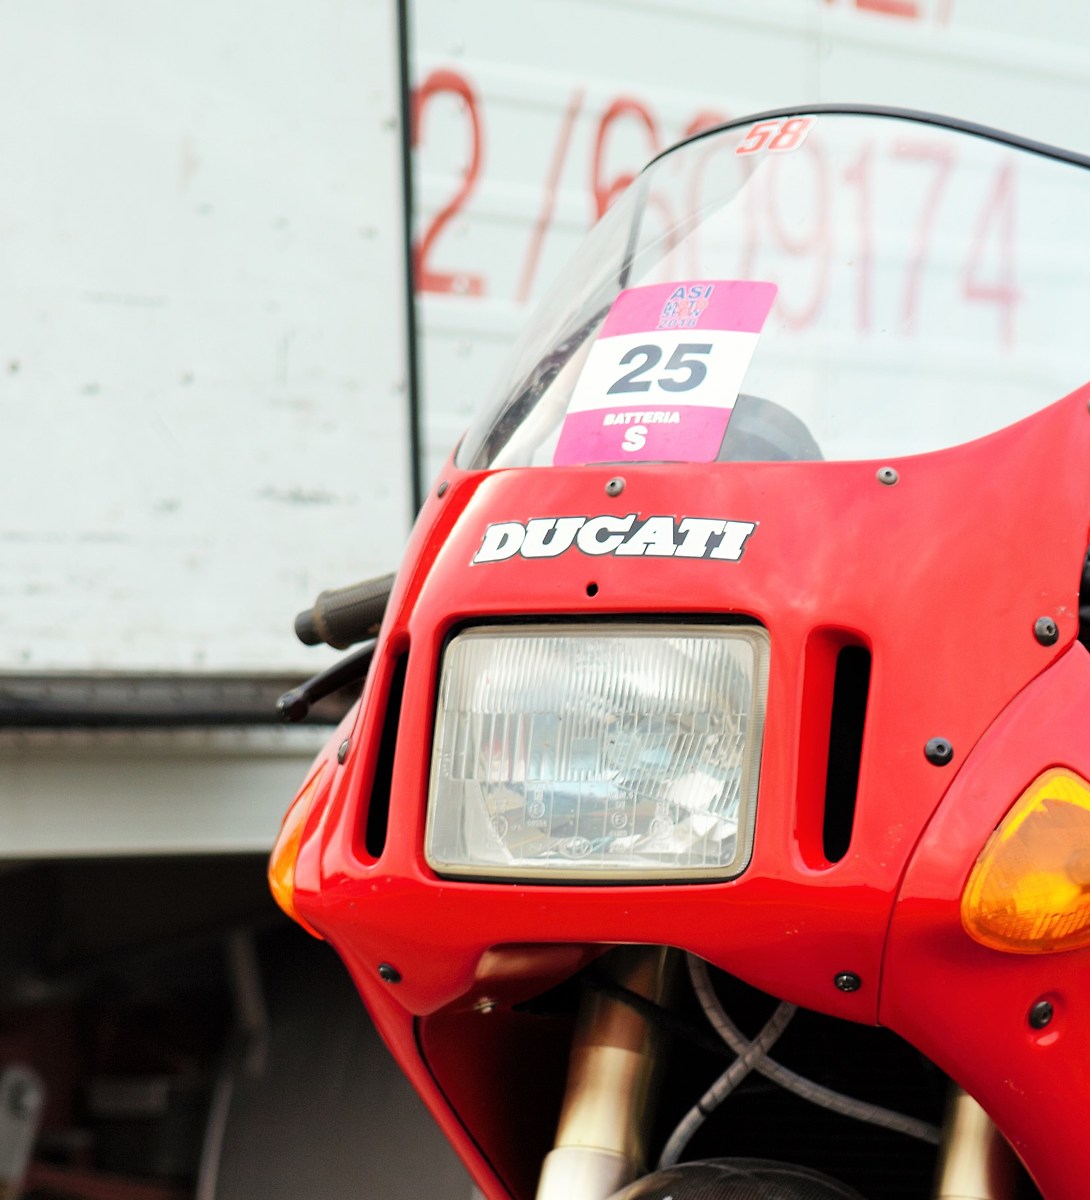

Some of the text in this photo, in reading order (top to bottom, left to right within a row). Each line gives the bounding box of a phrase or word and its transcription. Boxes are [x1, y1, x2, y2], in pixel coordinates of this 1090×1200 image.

[735, 116, 813, 154] 58
[669, 285, 714, 300] ASI
[606, 343, 714, 396] 25
[603, 411, 681, 427] BATTERIA
[621, 425, 649, 453] S
[471, 514, 757, 564] DUCATI
